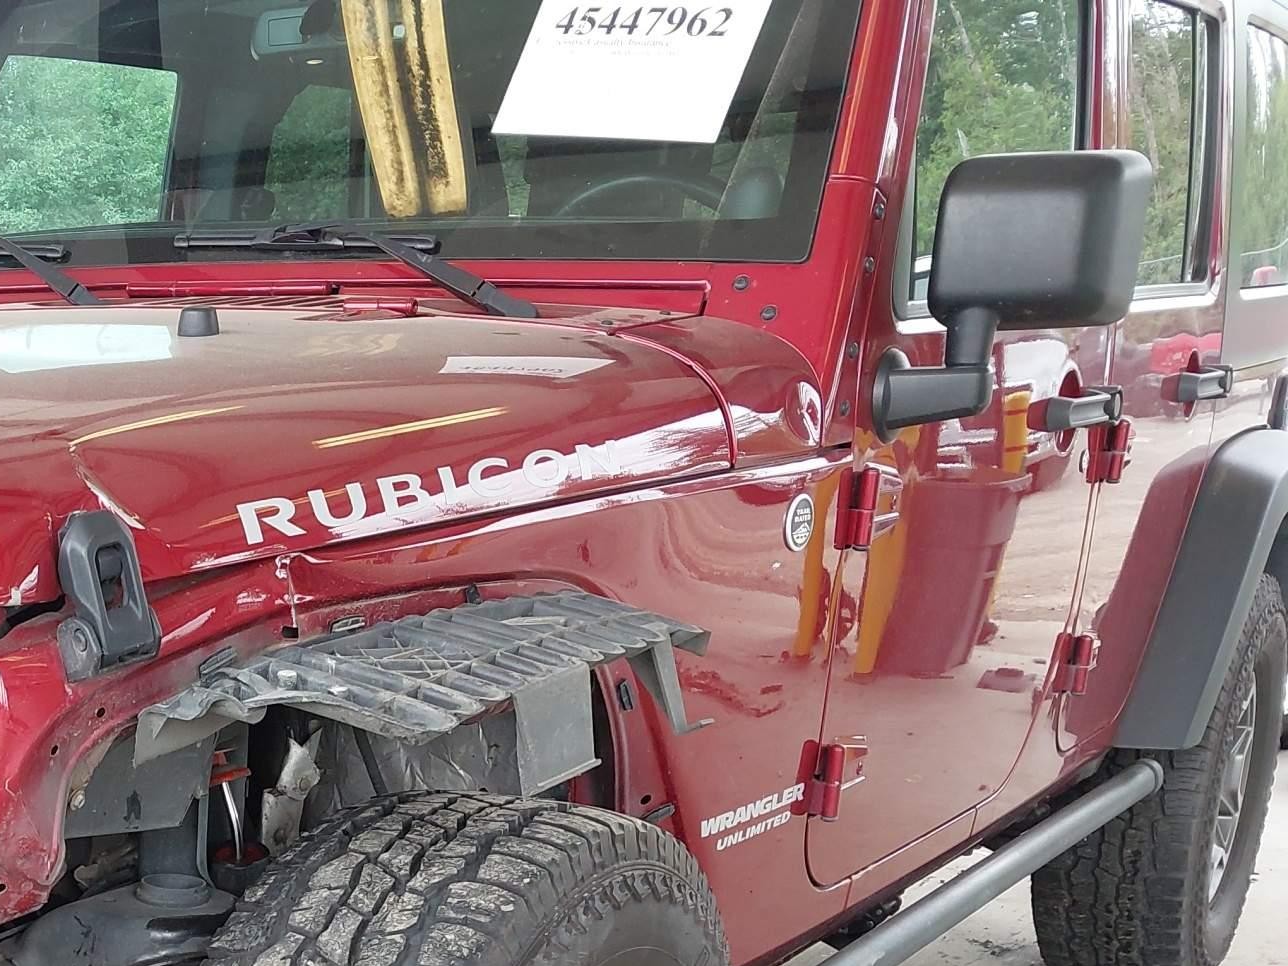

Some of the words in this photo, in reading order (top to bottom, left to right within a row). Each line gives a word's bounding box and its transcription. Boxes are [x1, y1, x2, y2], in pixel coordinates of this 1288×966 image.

[555, 6, 733, 37] 45447962
[238, 439, 622, 545] RUBICON
[700, 782, 805, 838] WRANGLER
[716, 810, 792, 851] UNLIMITED
